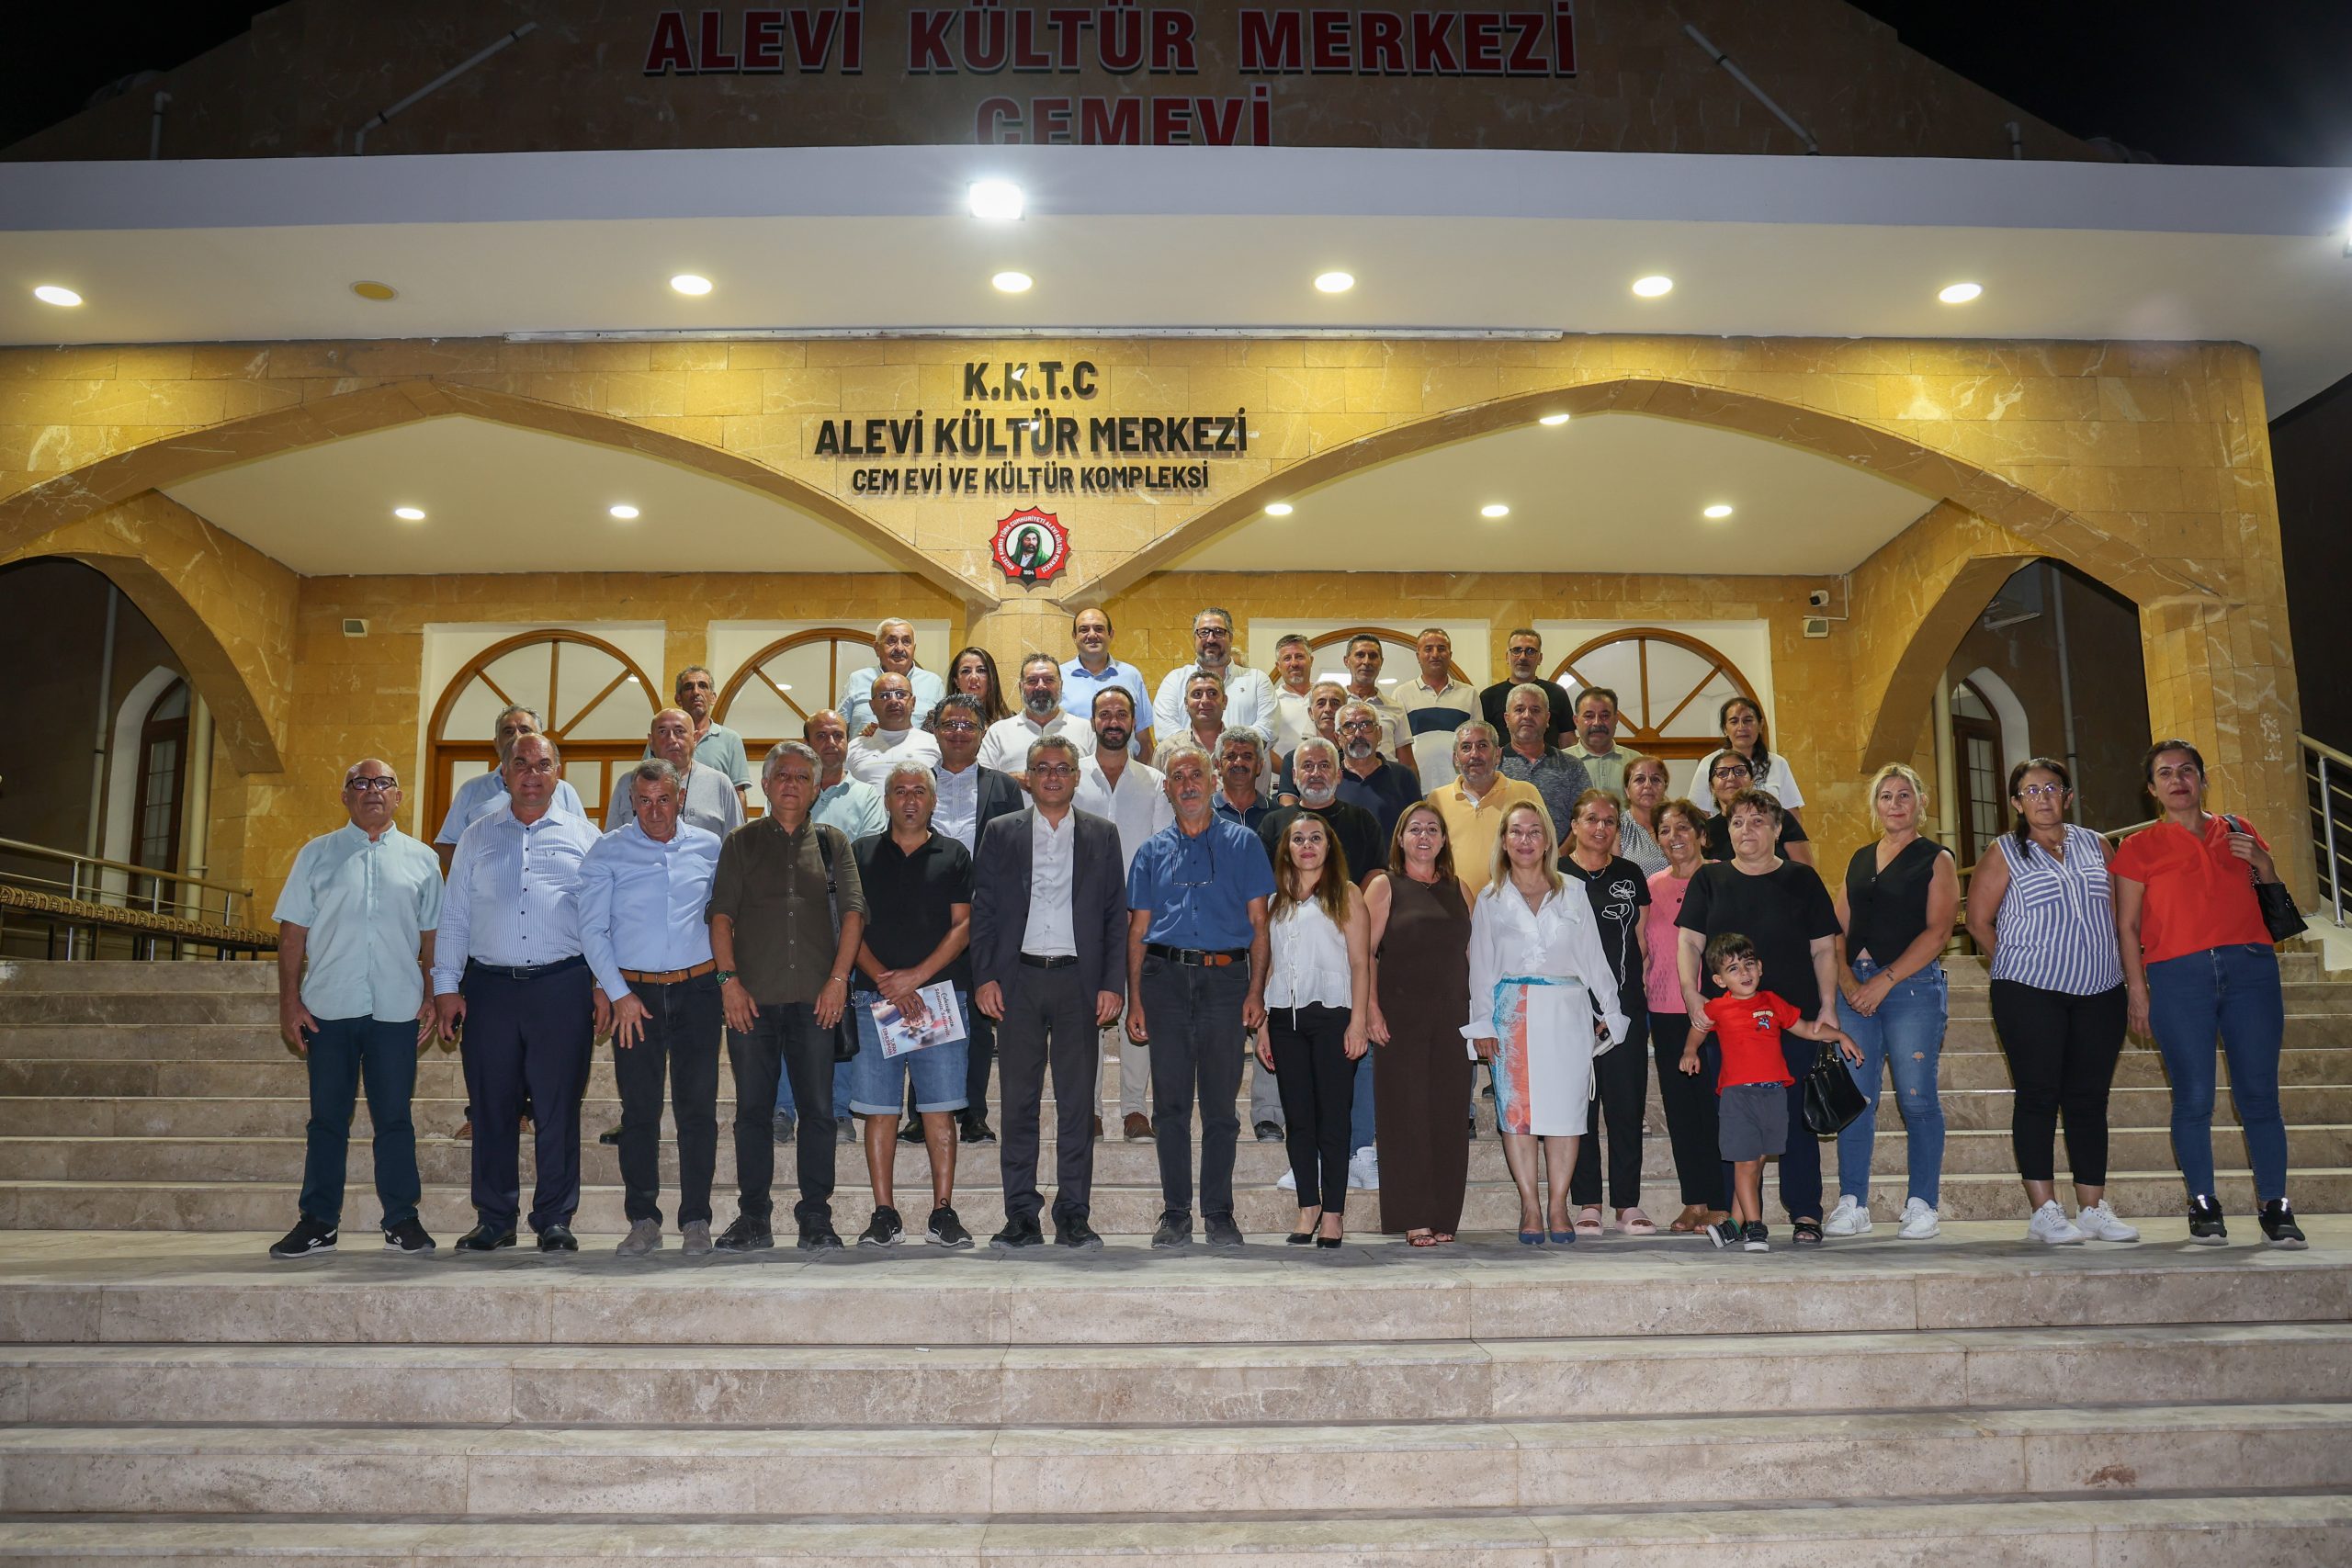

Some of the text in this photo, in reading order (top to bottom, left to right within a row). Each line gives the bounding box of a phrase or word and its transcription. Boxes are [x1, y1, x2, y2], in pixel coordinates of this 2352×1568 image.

[644, 0, 1577, 77] ALEVİ KÜLTÜR MERKEZİ
[974, 83, 1273, 147] CEMEVİ
[966, 361, 1096, 399] K.K.T.C
[815, 407, 1248, 456] ALEVİ KÜLTÜR MERKEZİ
[853, 459, 1209, 491] CEM EVİ VE KÜLTÜR KOMPLEKSİ
[1045, 521, 1059, 535] ALEVİ
[1055, 534, 1063, 554] KÜLTÜR
